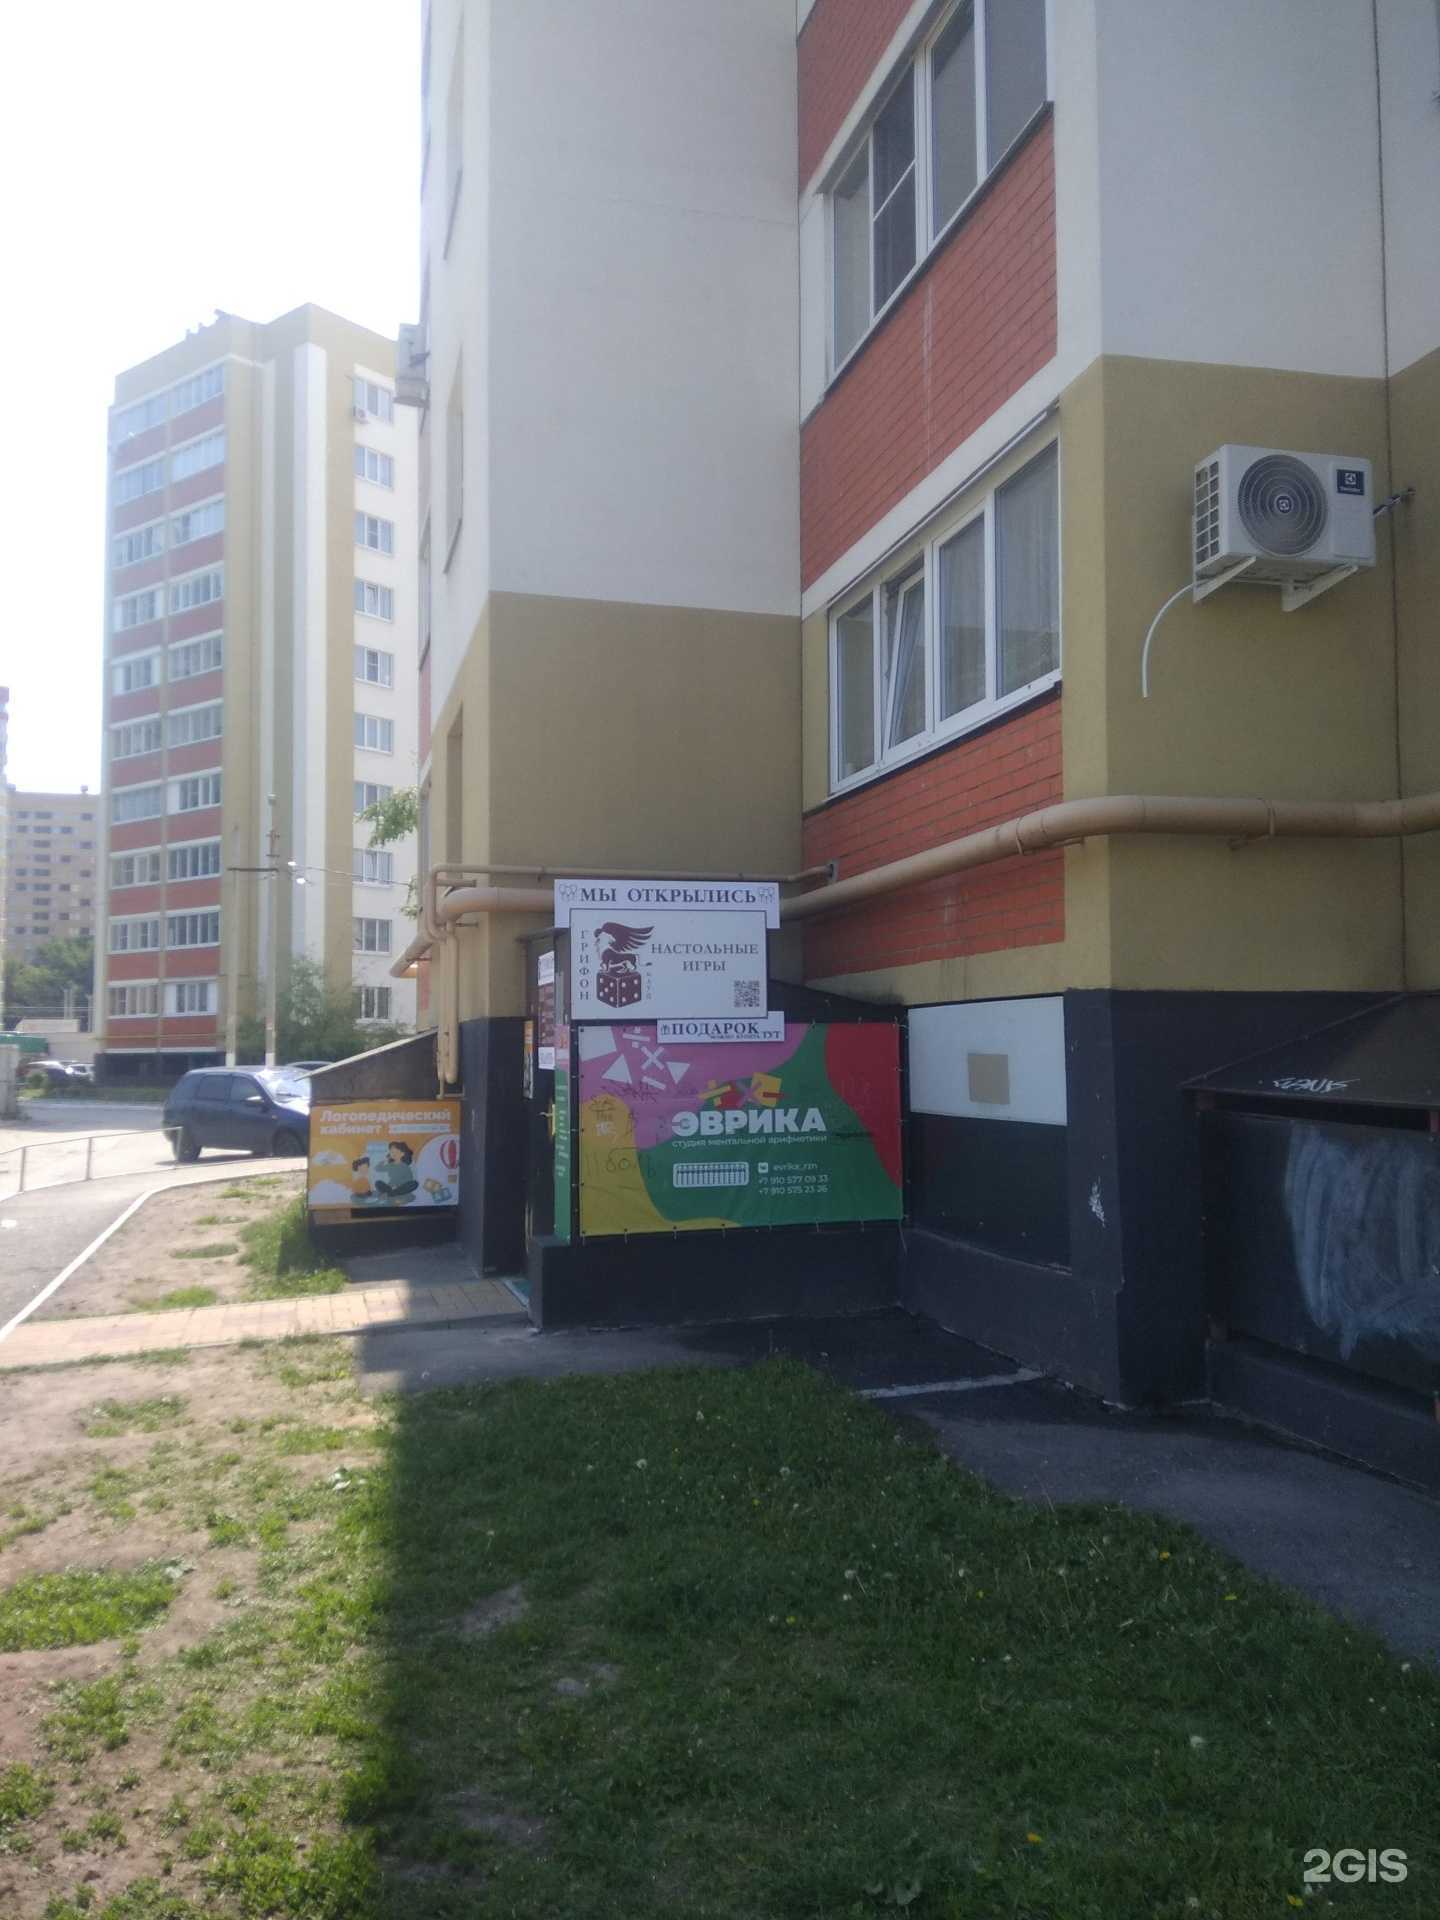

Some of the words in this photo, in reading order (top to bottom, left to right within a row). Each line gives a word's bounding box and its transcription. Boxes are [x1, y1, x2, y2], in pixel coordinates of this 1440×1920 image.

[580, 888, 617, 902] МЫ
[627, 888, 757, 904] ОТКРЫЛИСЬ
[651, 943, 760, 955] НАСТОЛЬНЫЕ
[579, 929, 591, 1001] ГРИФОН
[683, 960, 727, 972] ИГРЫ
[672, 1022, 760, 1037] ПОДАРОК
[320, 1109, 451, 1122] Логопедический
[671, 1107, 827, 1137] ЭВРИКА
